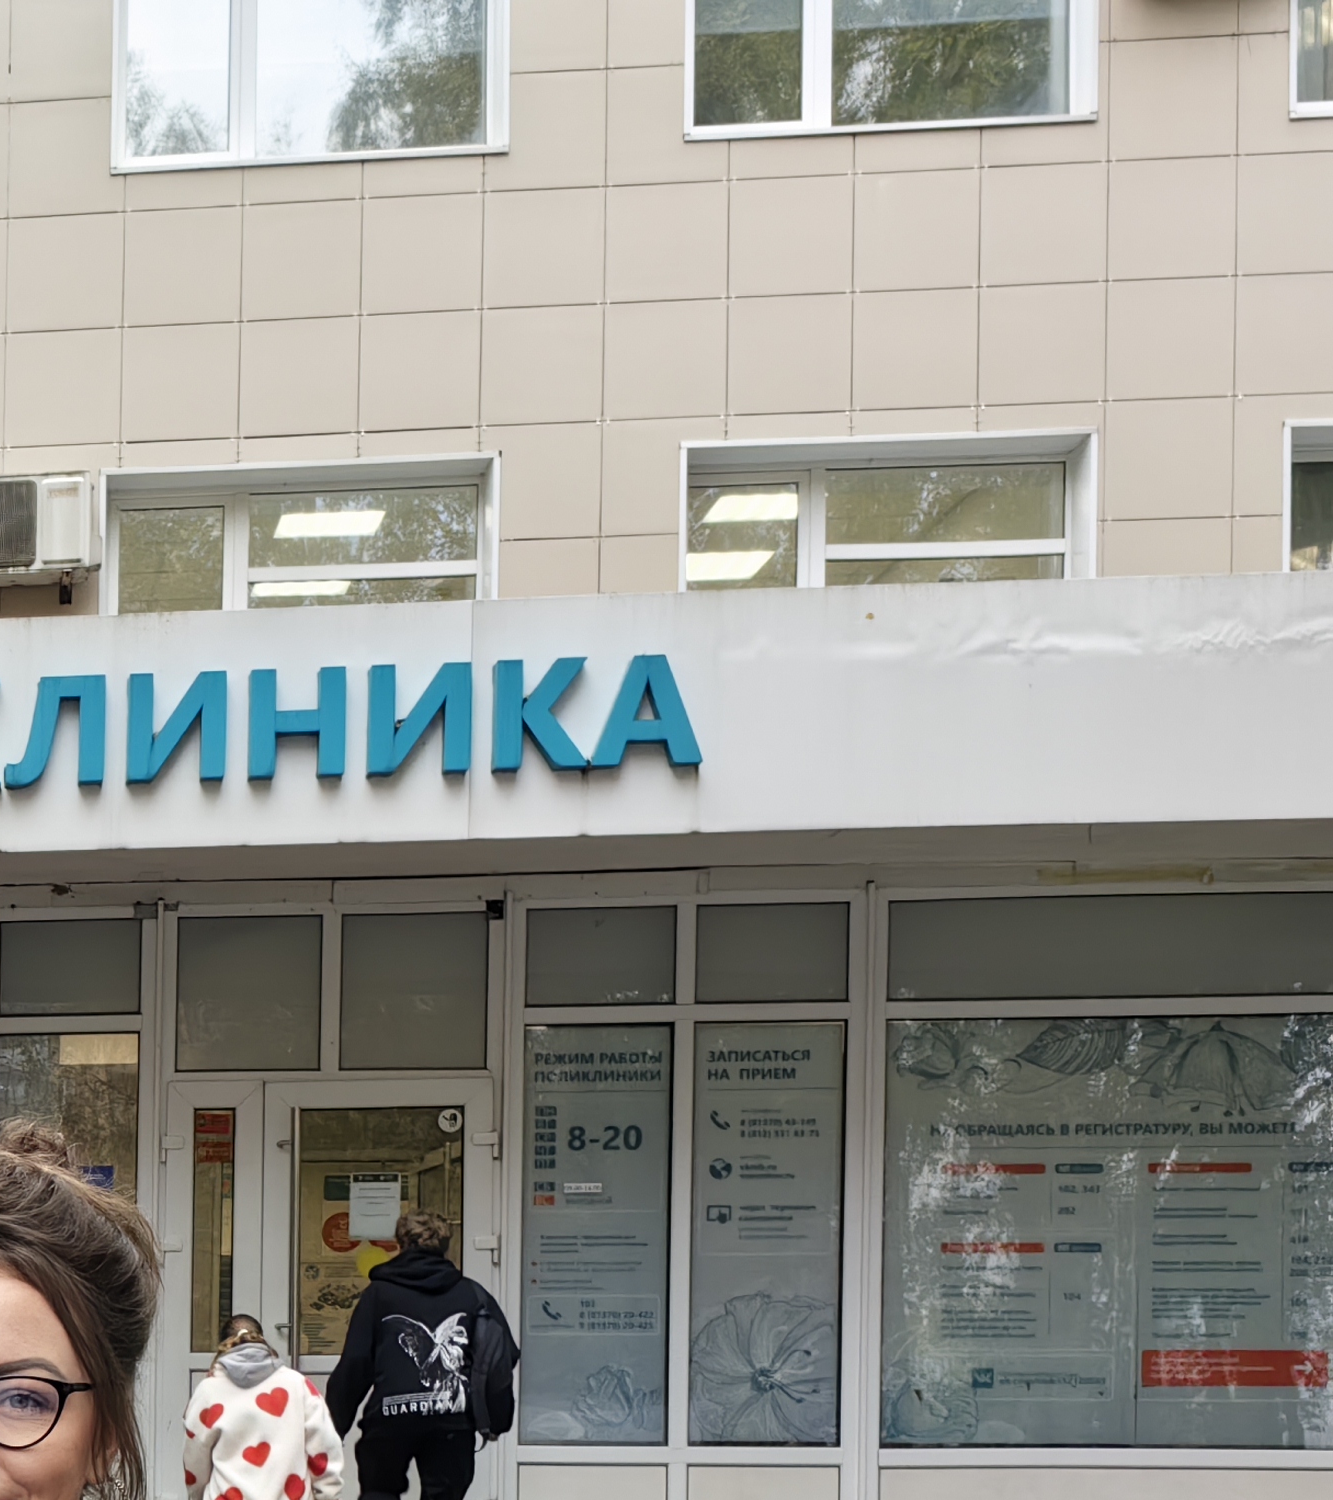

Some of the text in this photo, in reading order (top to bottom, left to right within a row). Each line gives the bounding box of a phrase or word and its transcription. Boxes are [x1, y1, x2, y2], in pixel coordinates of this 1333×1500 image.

[534, 1051, 663, 1066] РЕЖИМ РАБОТЫ
[707, 1049, 811, 1063] ЗАПИСАТЬСЯ
[534, 1070, 662, 1083] ПОЛИКЛИНИКИ
[707, 1067, 797, 1081] НА ПРИЕМ
[1060, 1124, 1070, 1136] В
[1075, 1122, 1194, 1137] РЕГИСТРАТУРУ,
[1199, 1123, 1223, 1135] ВЫ
[567, 1125, 643, 1151] 8-20
